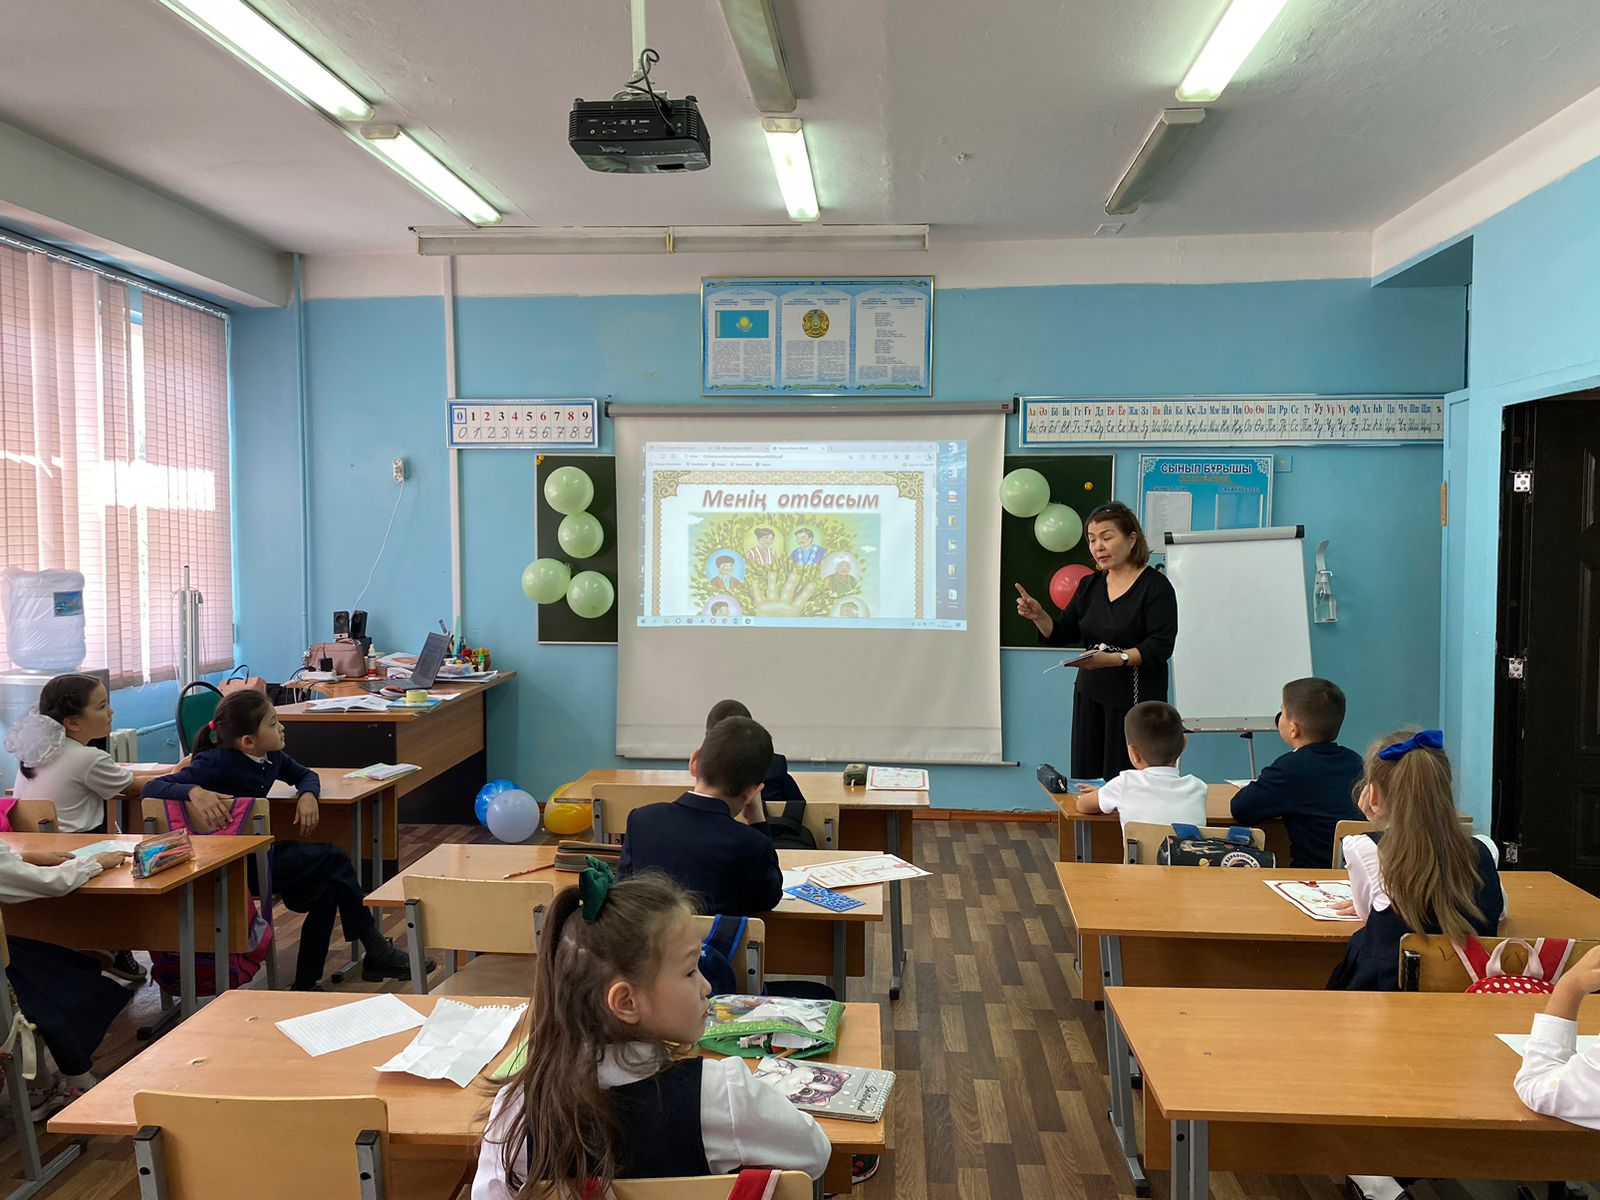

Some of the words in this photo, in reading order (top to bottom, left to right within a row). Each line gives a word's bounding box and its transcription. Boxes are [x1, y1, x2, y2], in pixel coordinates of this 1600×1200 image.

[457, 412, 463, 421] 0
[471, 412, 475, 421] 1
[484, 412, 490, 421] 2
[499, 412, 504, 421] 3
[512, 412, 518, 421] 4
[526, 412, 532, 421] 5
[540, 412, 546, 421] 6
[554, 412, 560, 421] 7
[568, 412, 574, 421] 8
[582, 412, 588, 421] 9
[458, 427, 467, 439] 0
[473, 427, 480, 439] 1
[488, 427, 495, 439] 2
[502, 427, 508, 439] 3
[515, 427, 522, 439] 4
[529, 427, 537, 439] 5
[542, 427, 550, 439] 6
[557, 427, 565, 439] 7
[570, 427, 579, 439] 8
[584, 427, 592, 439] 9
[1162, 464, 1201, 474] СЫНЫП
[1204, 464, 1252, 474] БҰРЫШЫ
[702, 489, 766, 511] Менің
[778, 489, 880, 509] отбасым
